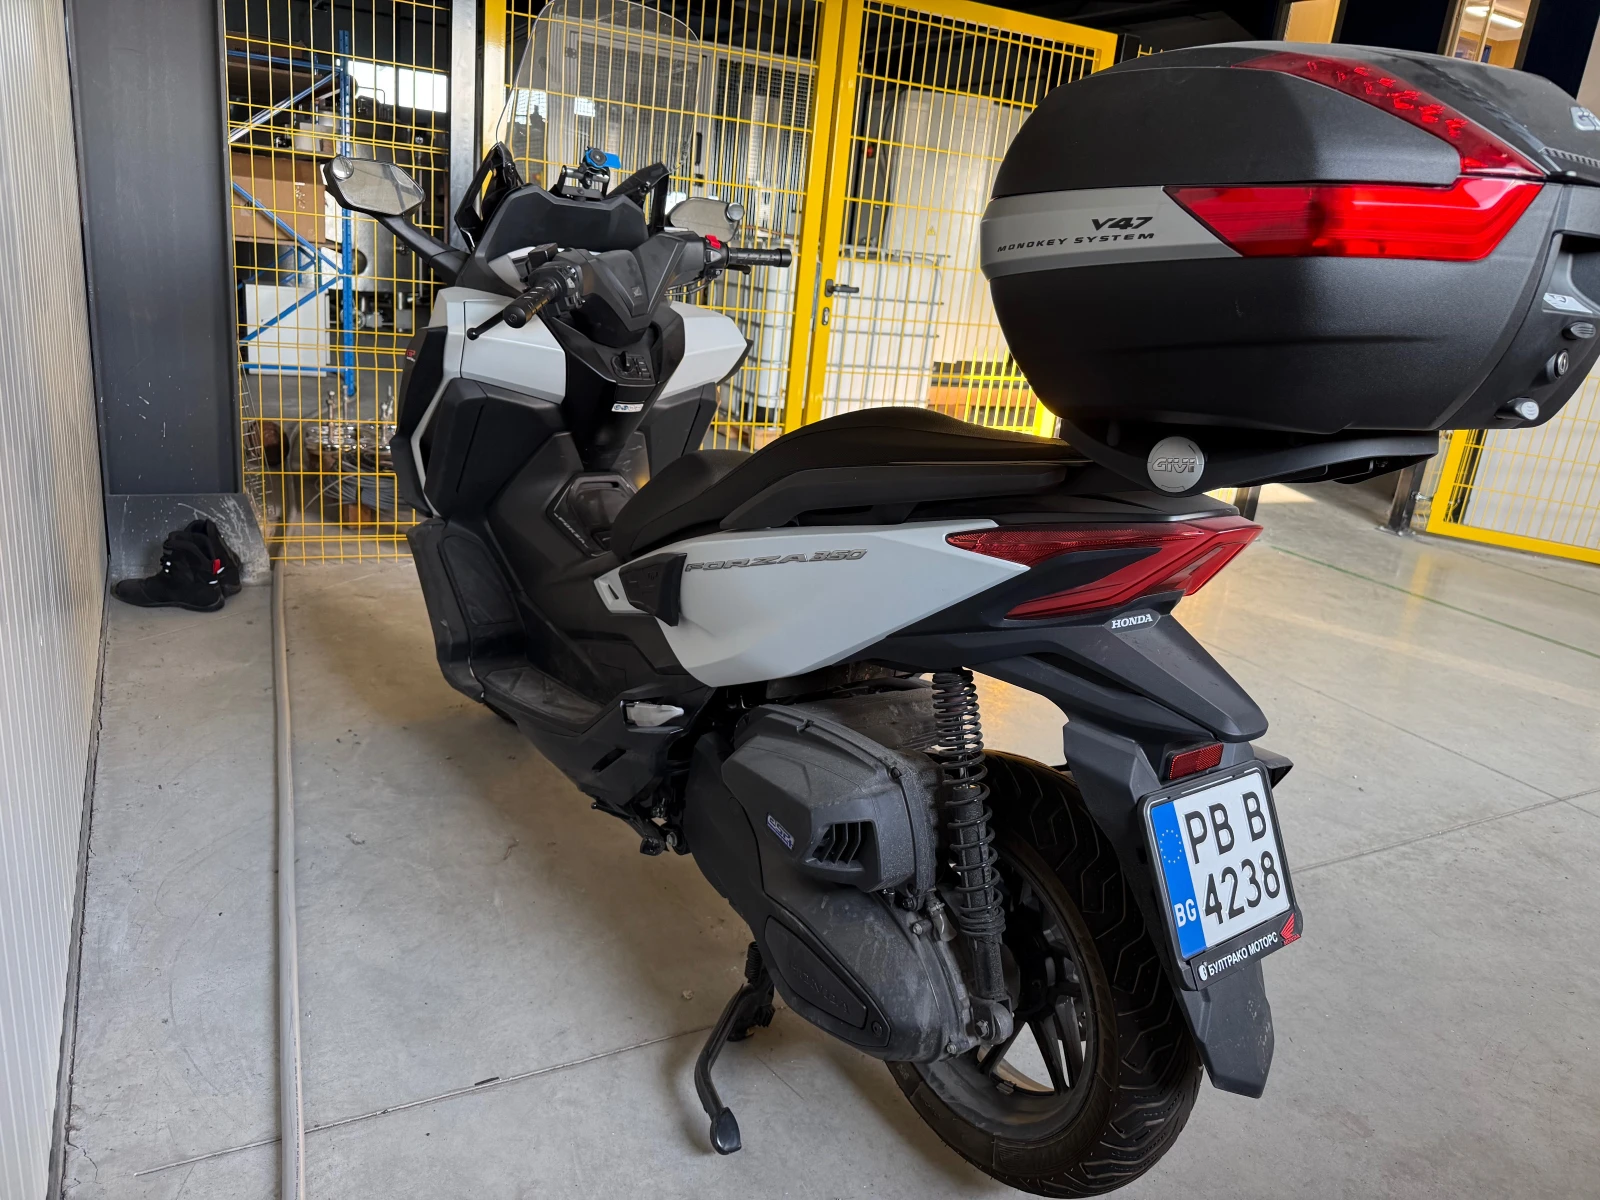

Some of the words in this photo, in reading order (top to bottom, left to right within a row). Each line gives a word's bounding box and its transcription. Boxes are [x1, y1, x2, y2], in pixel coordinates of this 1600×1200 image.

[1090, 216, 1153, 231] V47
[996, 237, 1068, 253] MONOKEY
[1073, 232, 1155, 245] SYSTEM
[1152, 457, 1196, 473] GIVI
[684, 553, 808, 572] FORZA
[808, 548, 868, 562] 350
[1111, 613, 1153, 629] HONDA
[1204, 850, 1281, 925] 4238
[1173, 898, 1197, 928] BG
[1207, 947, 1248, 976] БУЛТРАКО
[1247, 932, 1278, 956] МОТОРС
